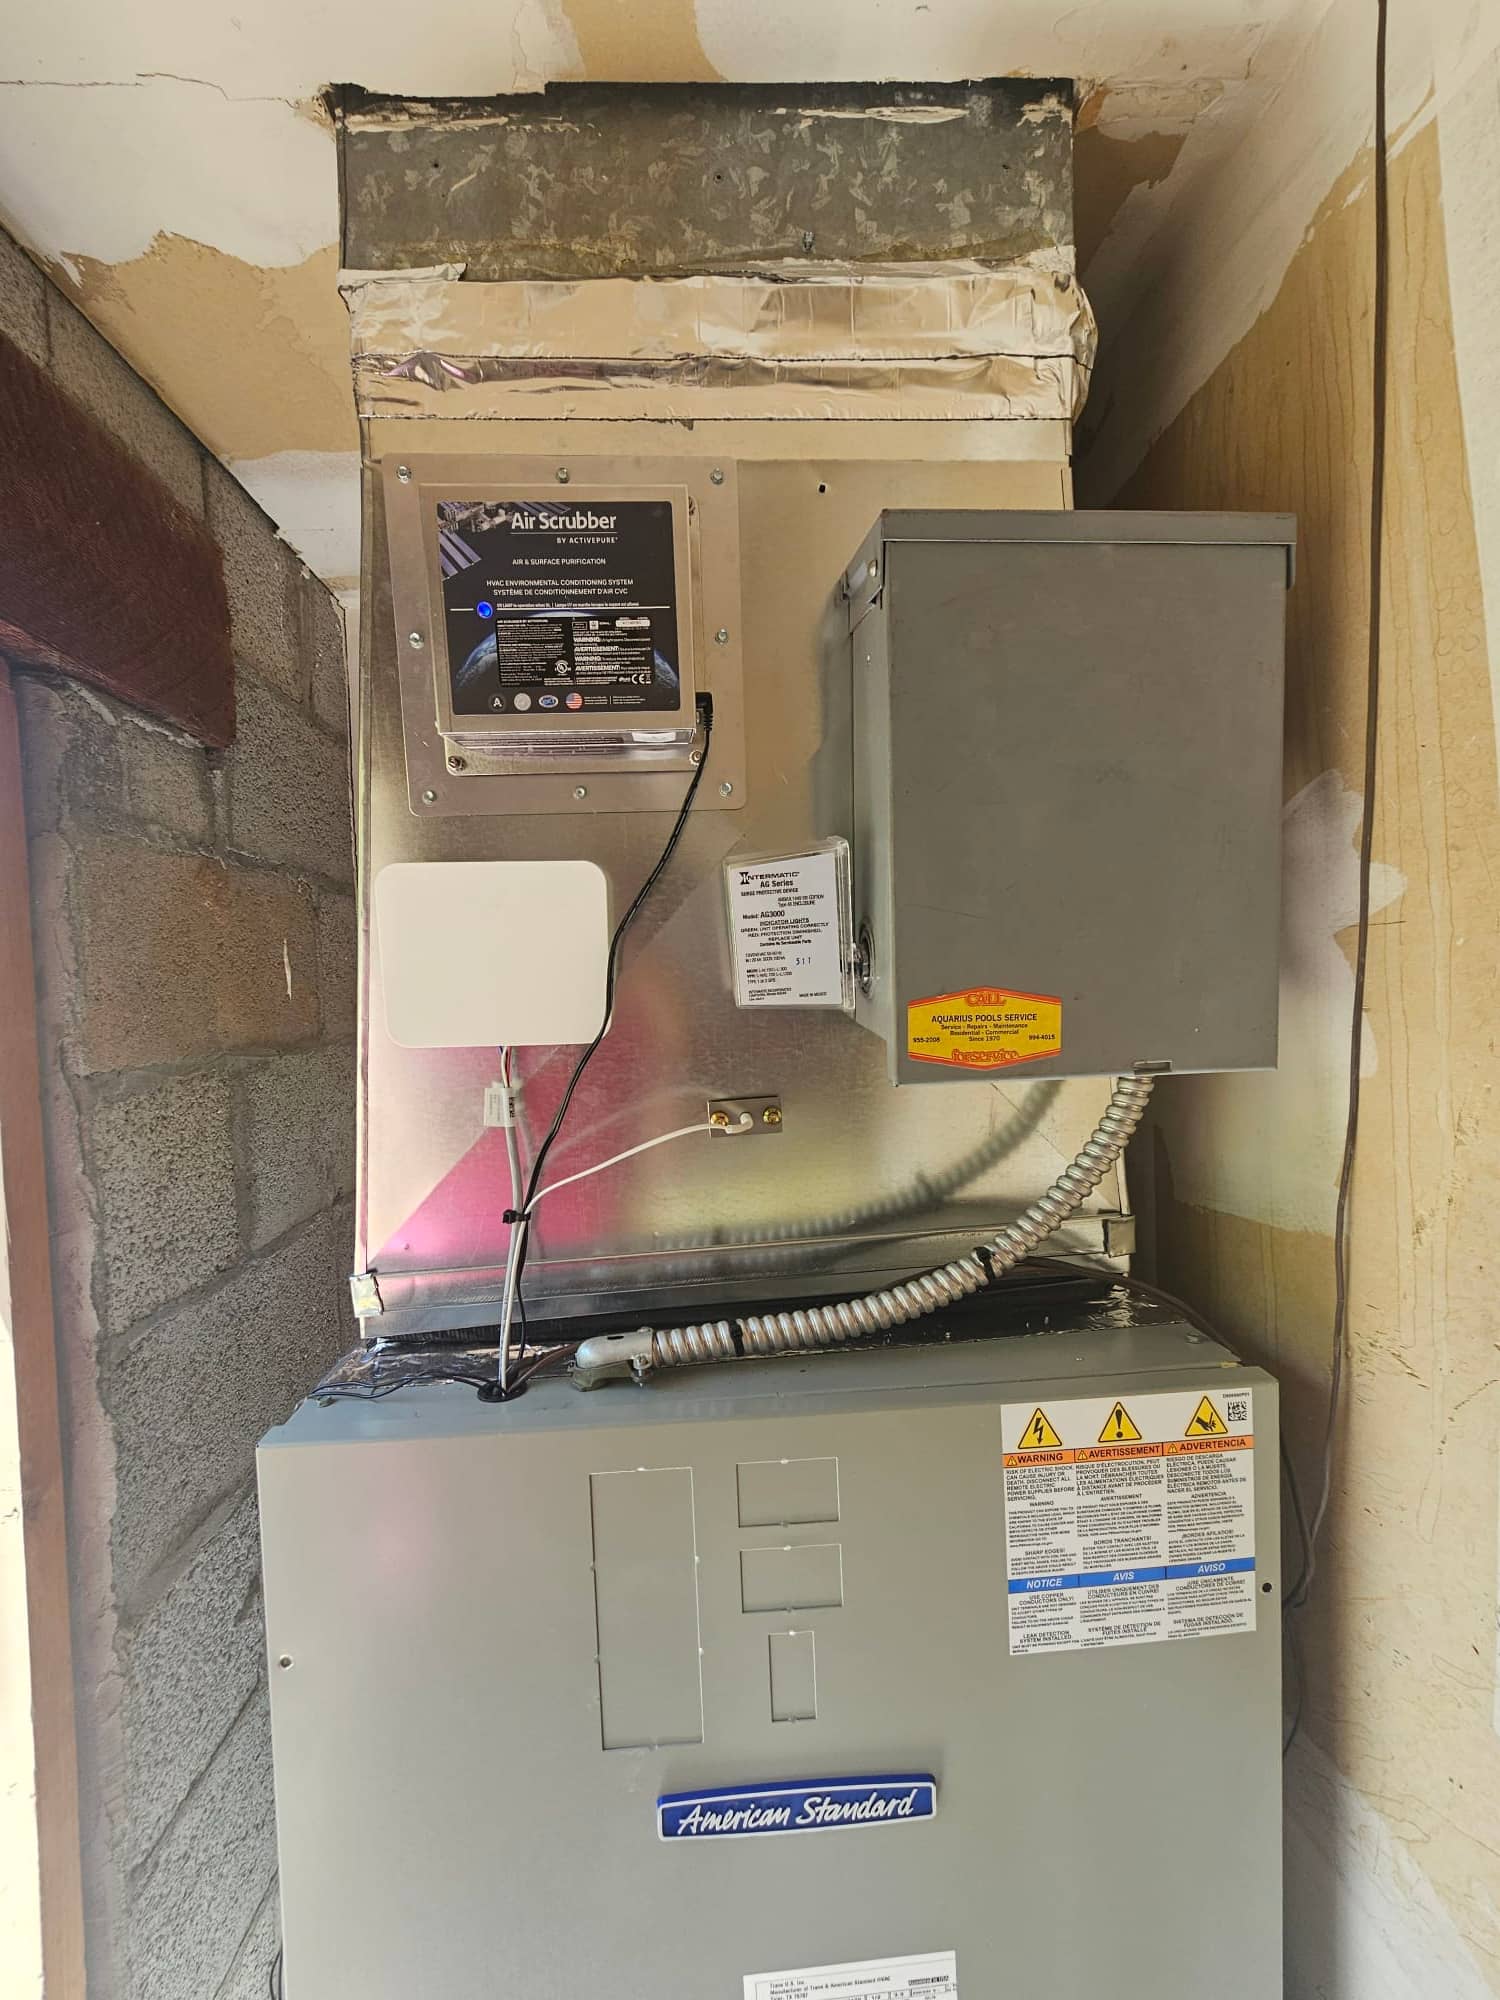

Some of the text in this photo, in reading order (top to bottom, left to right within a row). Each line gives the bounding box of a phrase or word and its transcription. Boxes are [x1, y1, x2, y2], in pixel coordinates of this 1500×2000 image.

[512, 511, 616, 529] Air Scrubber
[932, 1015, 972, 1023] AQUARIUS
[976, 1014, 1002, 1022] POOLS
[1180, 1439, 1246, 1451] ADVERTENCIA
[1089, 1446, 1160, 1458] AVERTISSEMENT
[1018, 1453, 1063, 1463] WARNING
[1198, 1563, 1225, 1573] AVISO
[1113, 1572, 1135, 1581] AVIS
[1027, 1578, 1063, 1589] NOTICE
[677, 1788, 919, 1836] American Standard
[770, 1987, 802, 1995] Manufacturer
